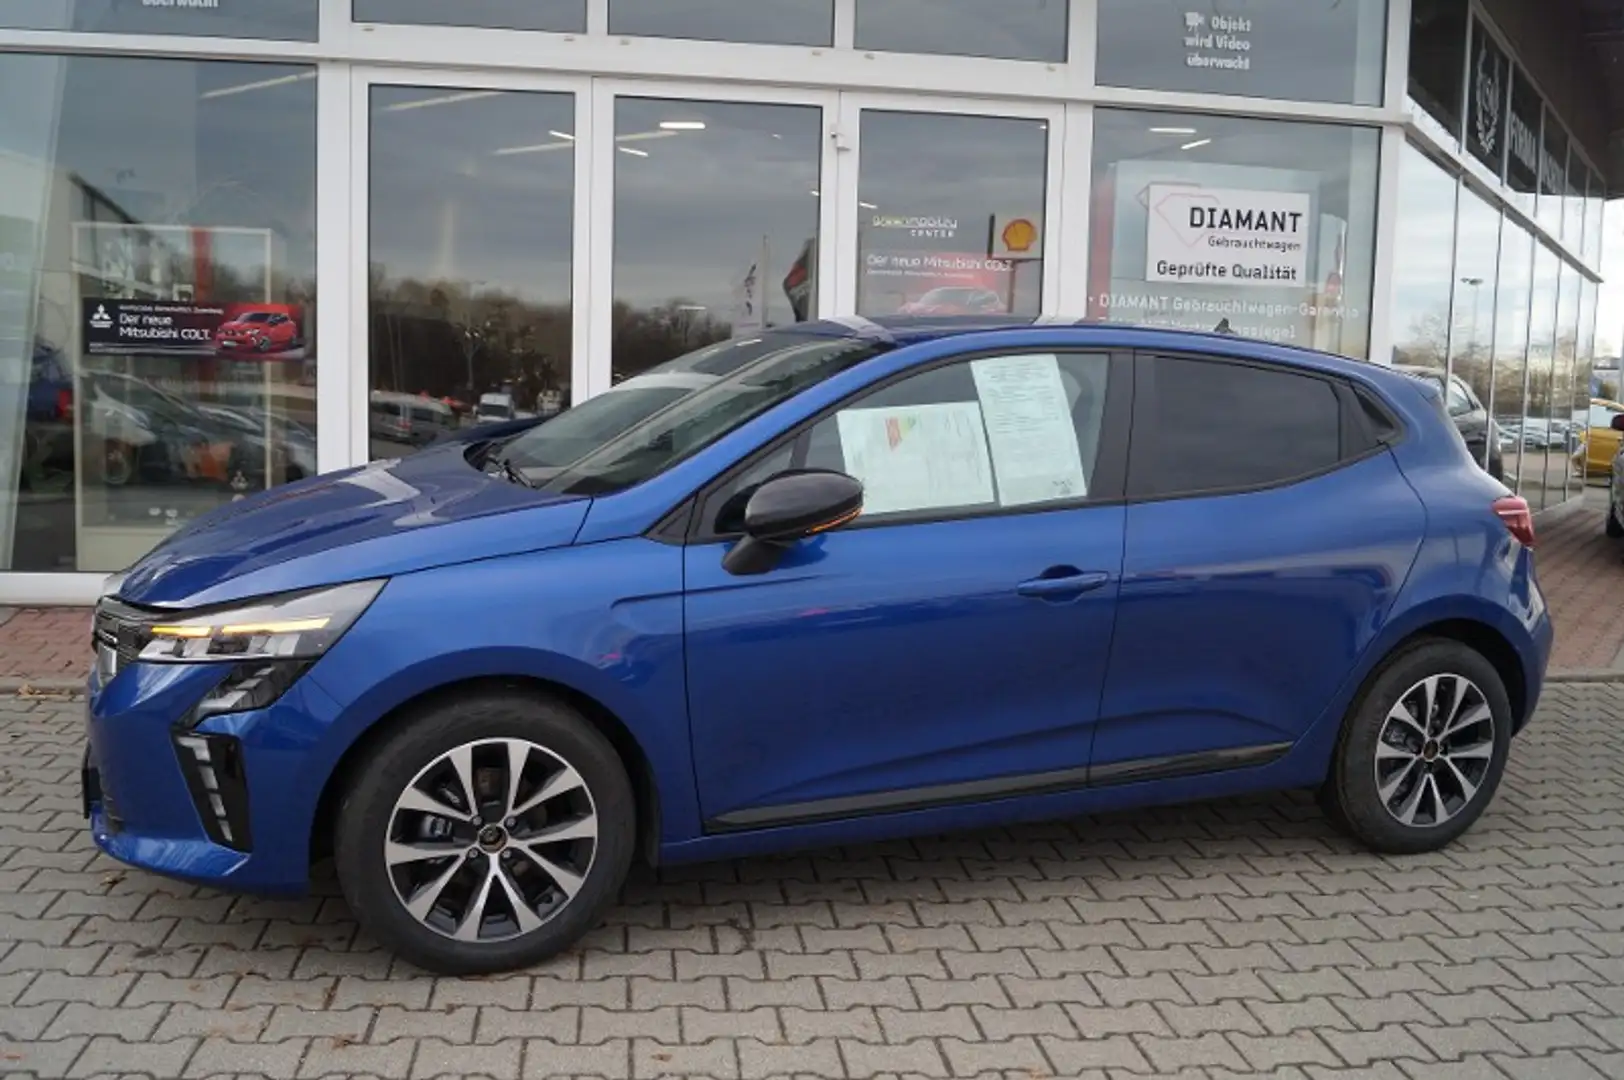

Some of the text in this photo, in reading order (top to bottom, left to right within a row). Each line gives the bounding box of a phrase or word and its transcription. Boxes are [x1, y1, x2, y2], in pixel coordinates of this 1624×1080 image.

[1211, 16, 1251, 33] Objekt
[1184, 33, 1250, 50] wird Video
[1187, 52, 1250, 69] überwacht
[1189, 206, 1302, 233] DIAMANT
[1207, 235, 1302, 253] Gebrauchtwagen
[1156, 259, 1297, 281] Geprüfte Qualität
[1099, 293, 1169, 311] DIAMANT
[119, 313, 140, 325] Der
[142, 315, 173, 326] neue
[119, 326, 178, 339] Mitsubishi
